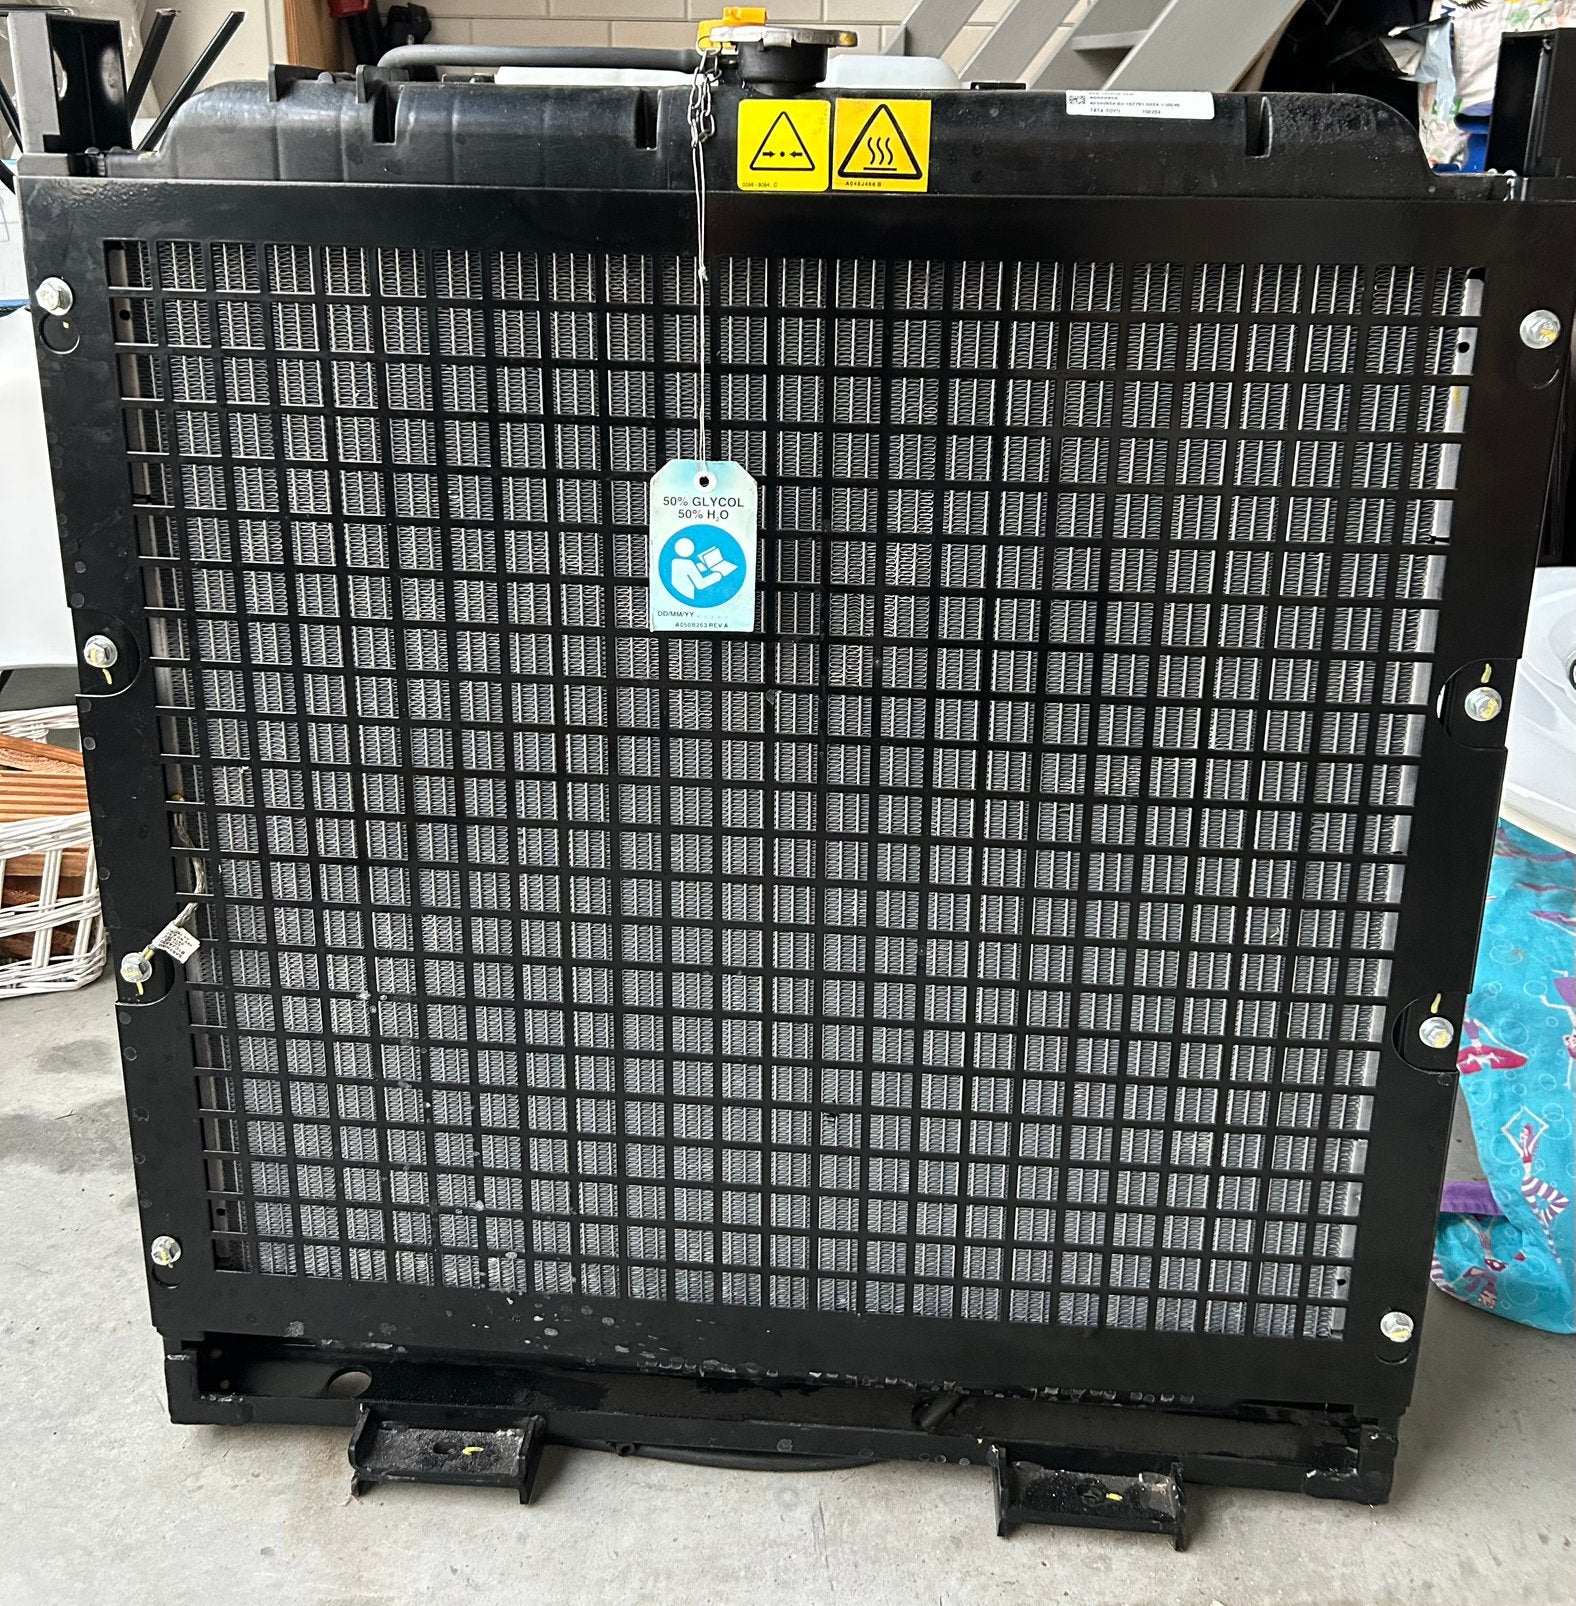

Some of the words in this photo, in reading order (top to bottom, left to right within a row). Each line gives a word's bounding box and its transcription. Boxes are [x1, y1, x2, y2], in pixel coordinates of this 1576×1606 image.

[663, 496, 688, 507] 50%
[692, 497, 744, 508] GLYCOL
[678, 509, 703, 520] 50%
[657, 610, 695, 618] DD/MM/YY
